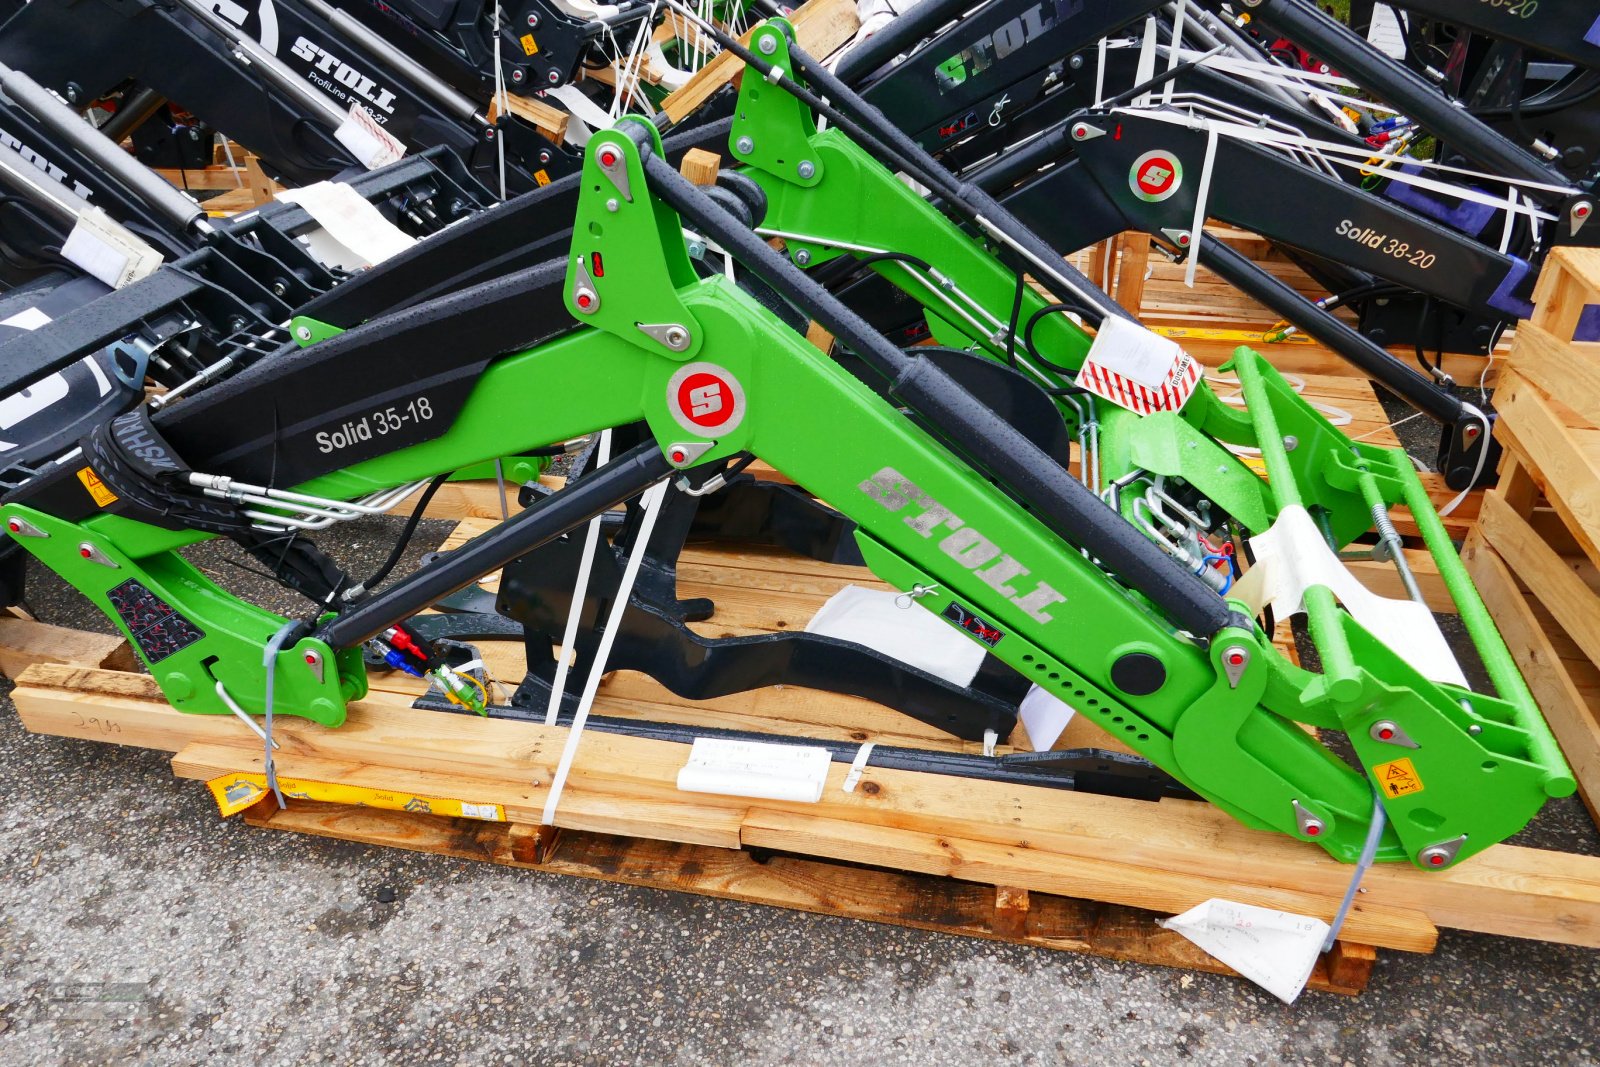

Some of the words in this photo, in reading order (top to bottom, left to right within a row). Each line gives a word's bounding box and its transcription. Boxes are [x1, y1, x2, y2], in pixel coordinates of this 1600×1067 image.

[1480, 0, 1538, 19] -20
[290, 36, 397, 115] STOLL
[307, 71, 346, 100] ProfiLine
[1141, 165, 1172, 188] S
[1335, 219, 1387, 249] Solid
[1383, 239, 1436, 269] 38-20
[689, 382, 723, 418] S
[315, 417, 372, 453] Solid
[373, 397, 434, 435] 35-18
[857, 466, 1068, 625] STOLL
